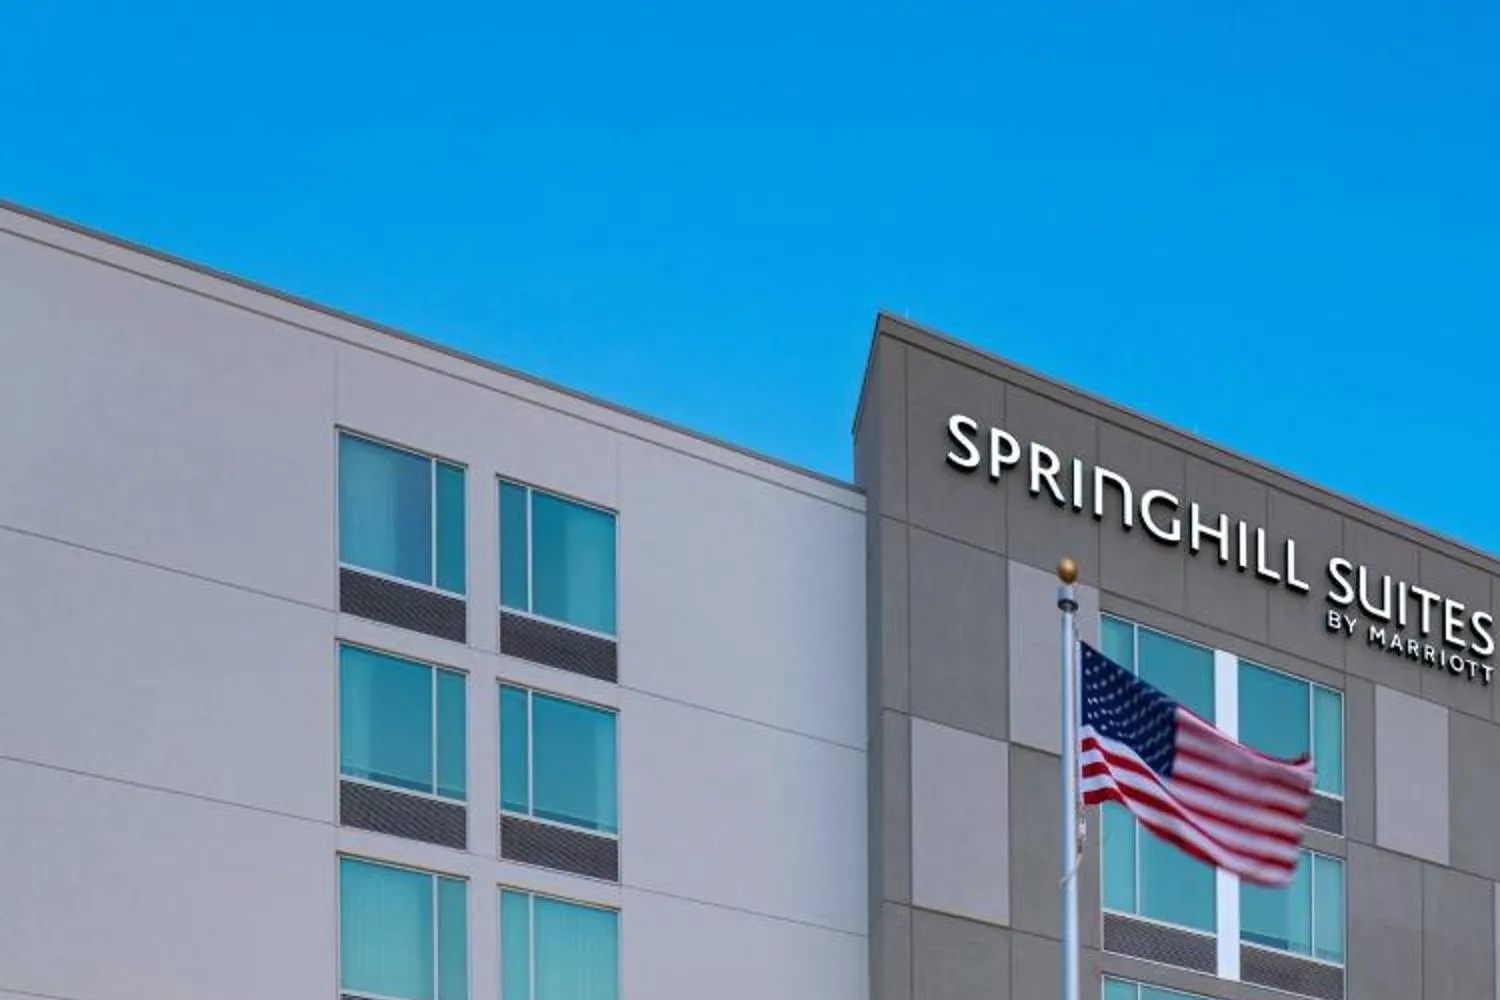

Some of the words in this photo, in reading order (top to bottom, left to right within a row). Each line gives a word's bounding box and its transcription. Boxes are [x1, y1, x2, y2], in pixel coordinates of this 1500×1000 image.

[946, 413, 1310, 592] SPRINGHILL
[1327, 556, 1496, 656] SUITES
[1326, 609, 1358, 635] BY
[1368, 624, 1495, 684] MARRIOTT
